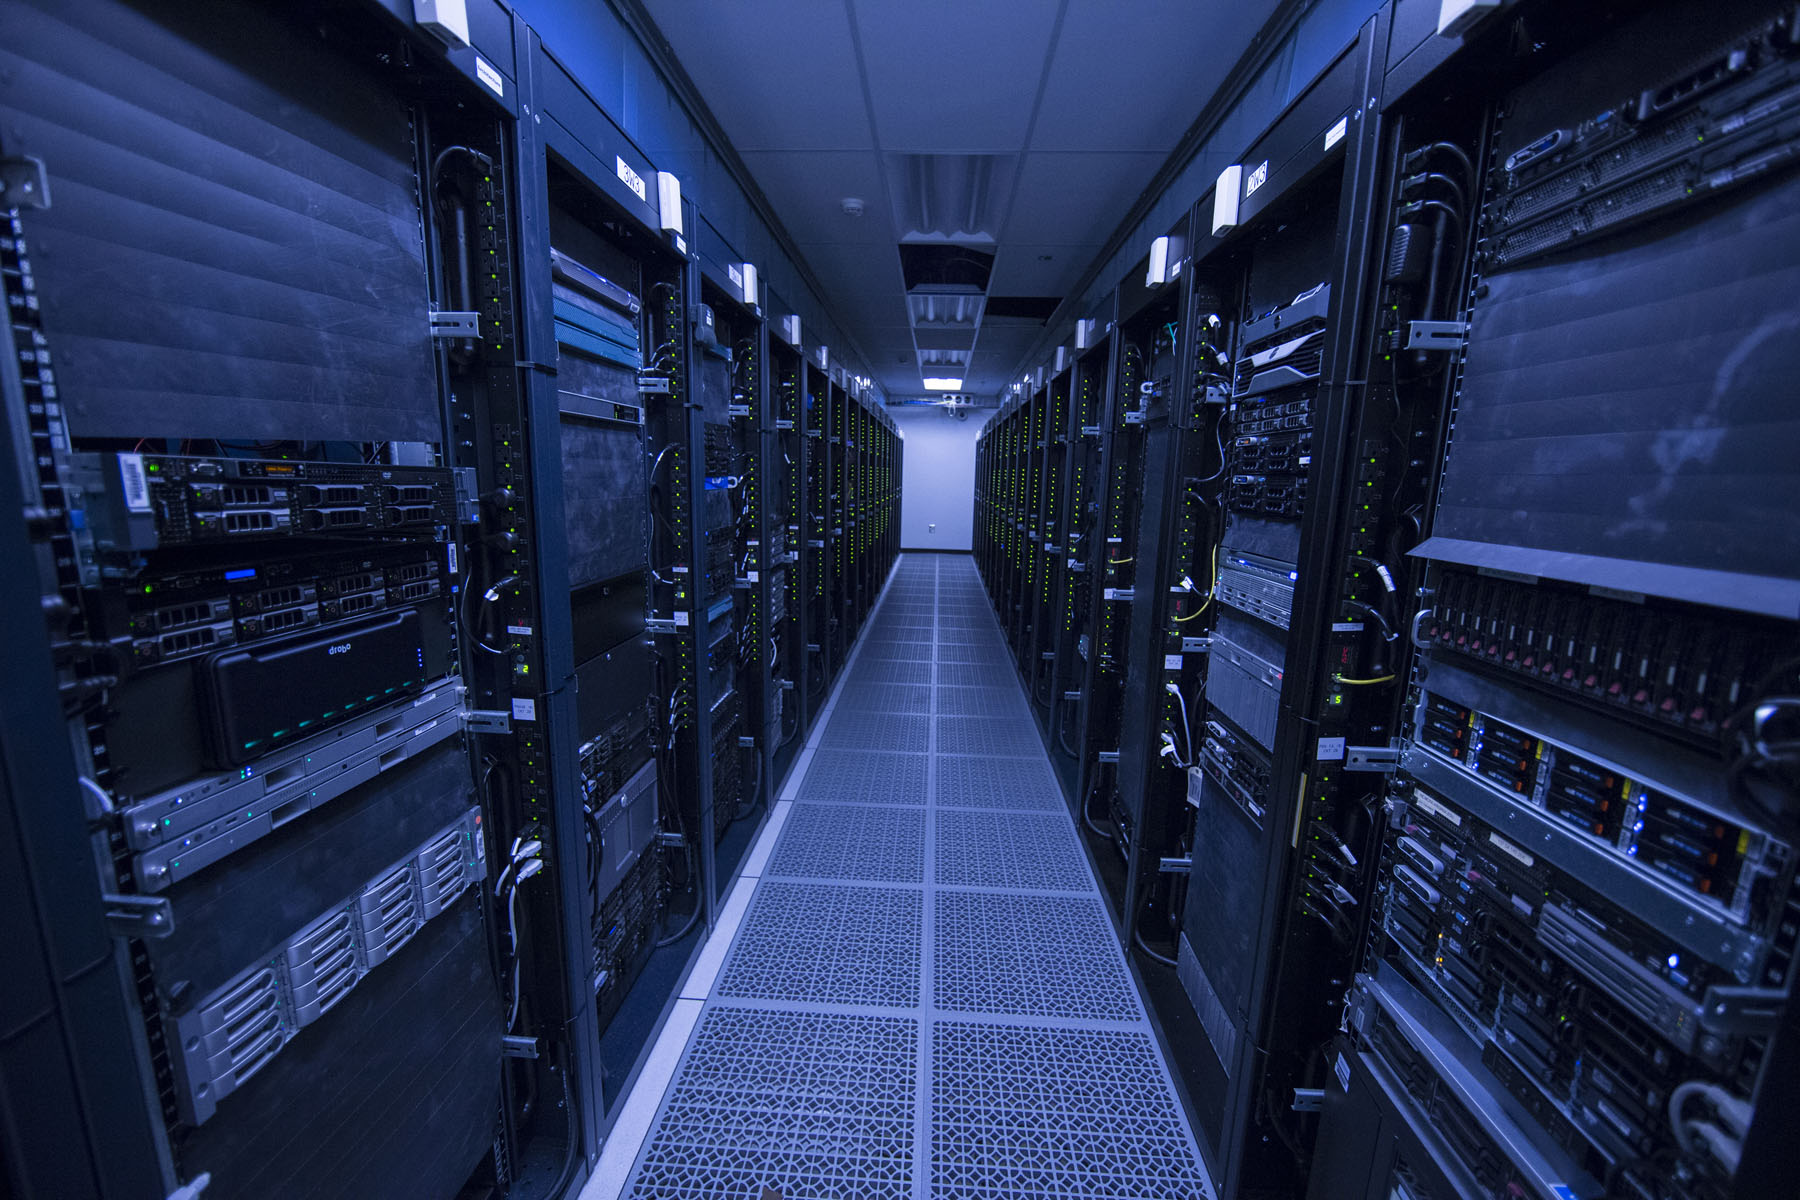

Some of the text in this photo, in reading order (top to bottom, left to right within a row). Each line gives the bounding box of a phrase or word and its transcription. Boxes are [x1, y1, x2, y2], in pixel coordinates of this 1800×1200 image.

[623, 164, 640, 194] 3W3
[1248, 163, 1266, 194] 2W3
[329, 643, 351, 655] drobo
[522, 664, 529, 673] 2
[1335, 695, 1342, 705] 5
